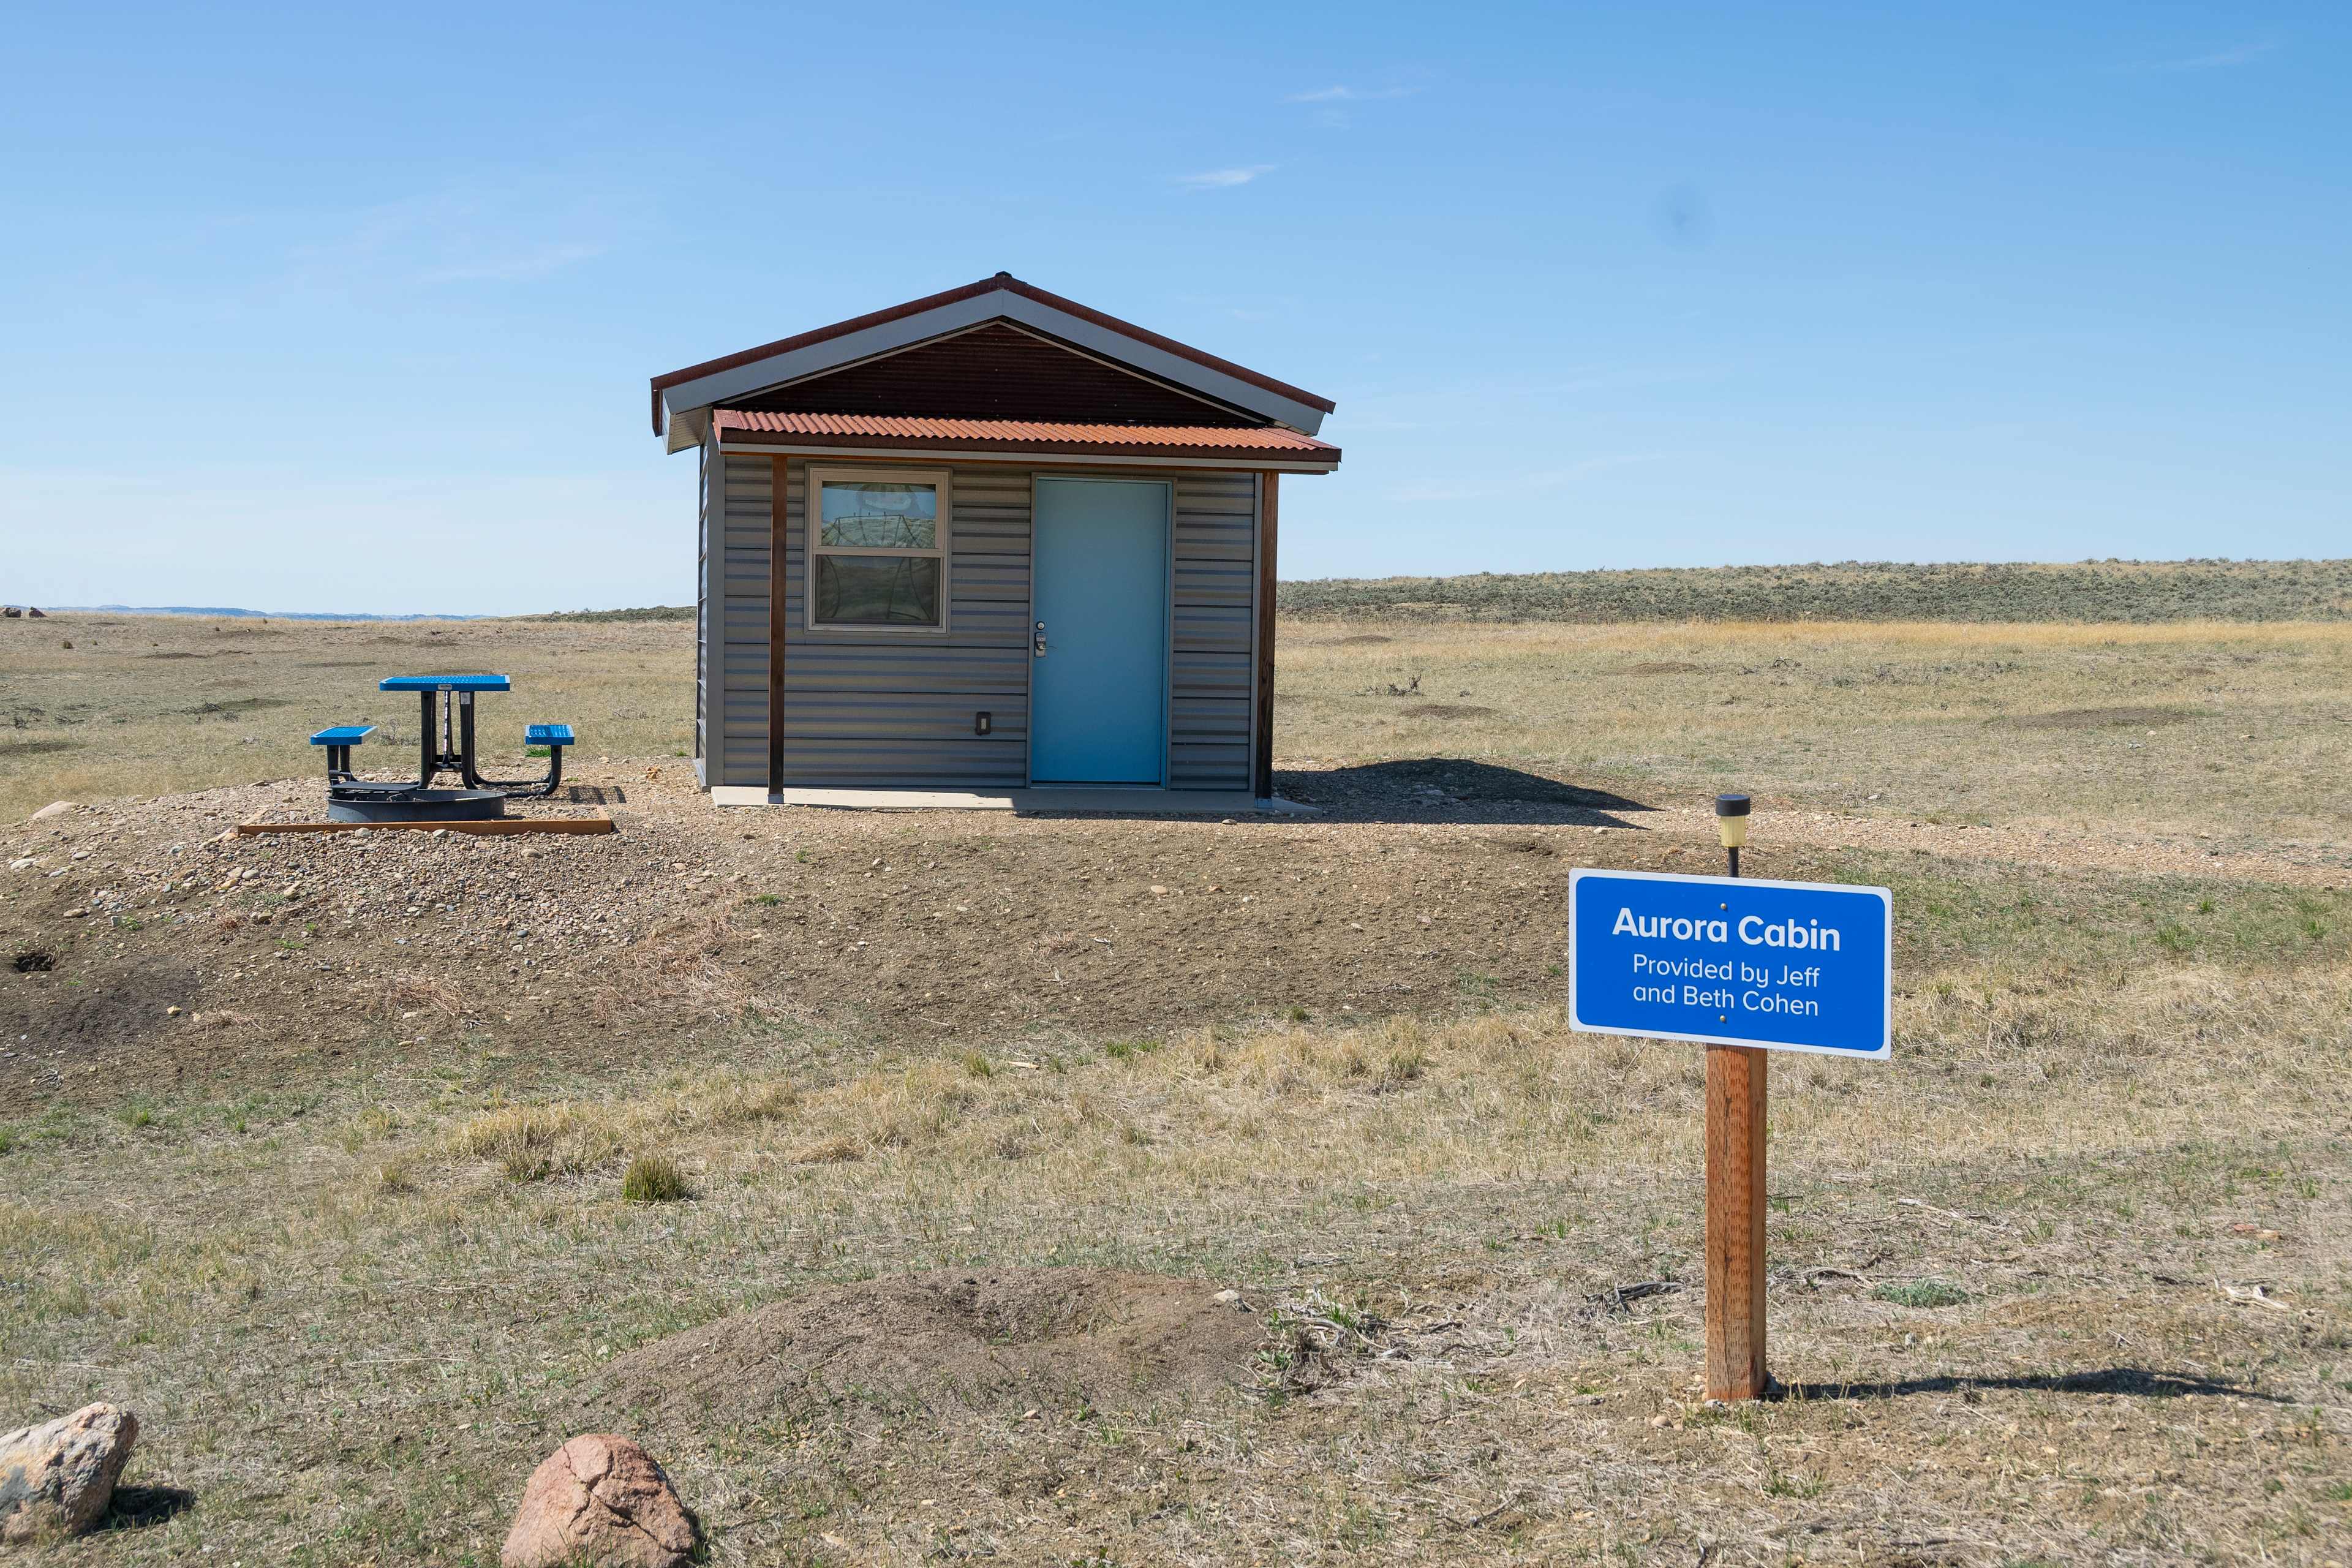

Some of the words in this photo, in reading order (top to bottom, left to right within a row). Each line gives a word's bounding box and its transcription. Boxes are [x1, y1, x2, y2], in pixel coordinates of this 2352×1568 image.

[1612, 907, 1727, 943] Aurora
[1738, 915, 1841, 951] Cabin
[1634, 954, 1732, 981] Provided
[1741, 962, 1769, 988] by
[1776, 965, 1820, 987] Jeff
[1633, 984, 1675, 1003] and
[1684, 986, 1734, 1008] Beth
[1743, 990, 1818, 1016] Cohen
